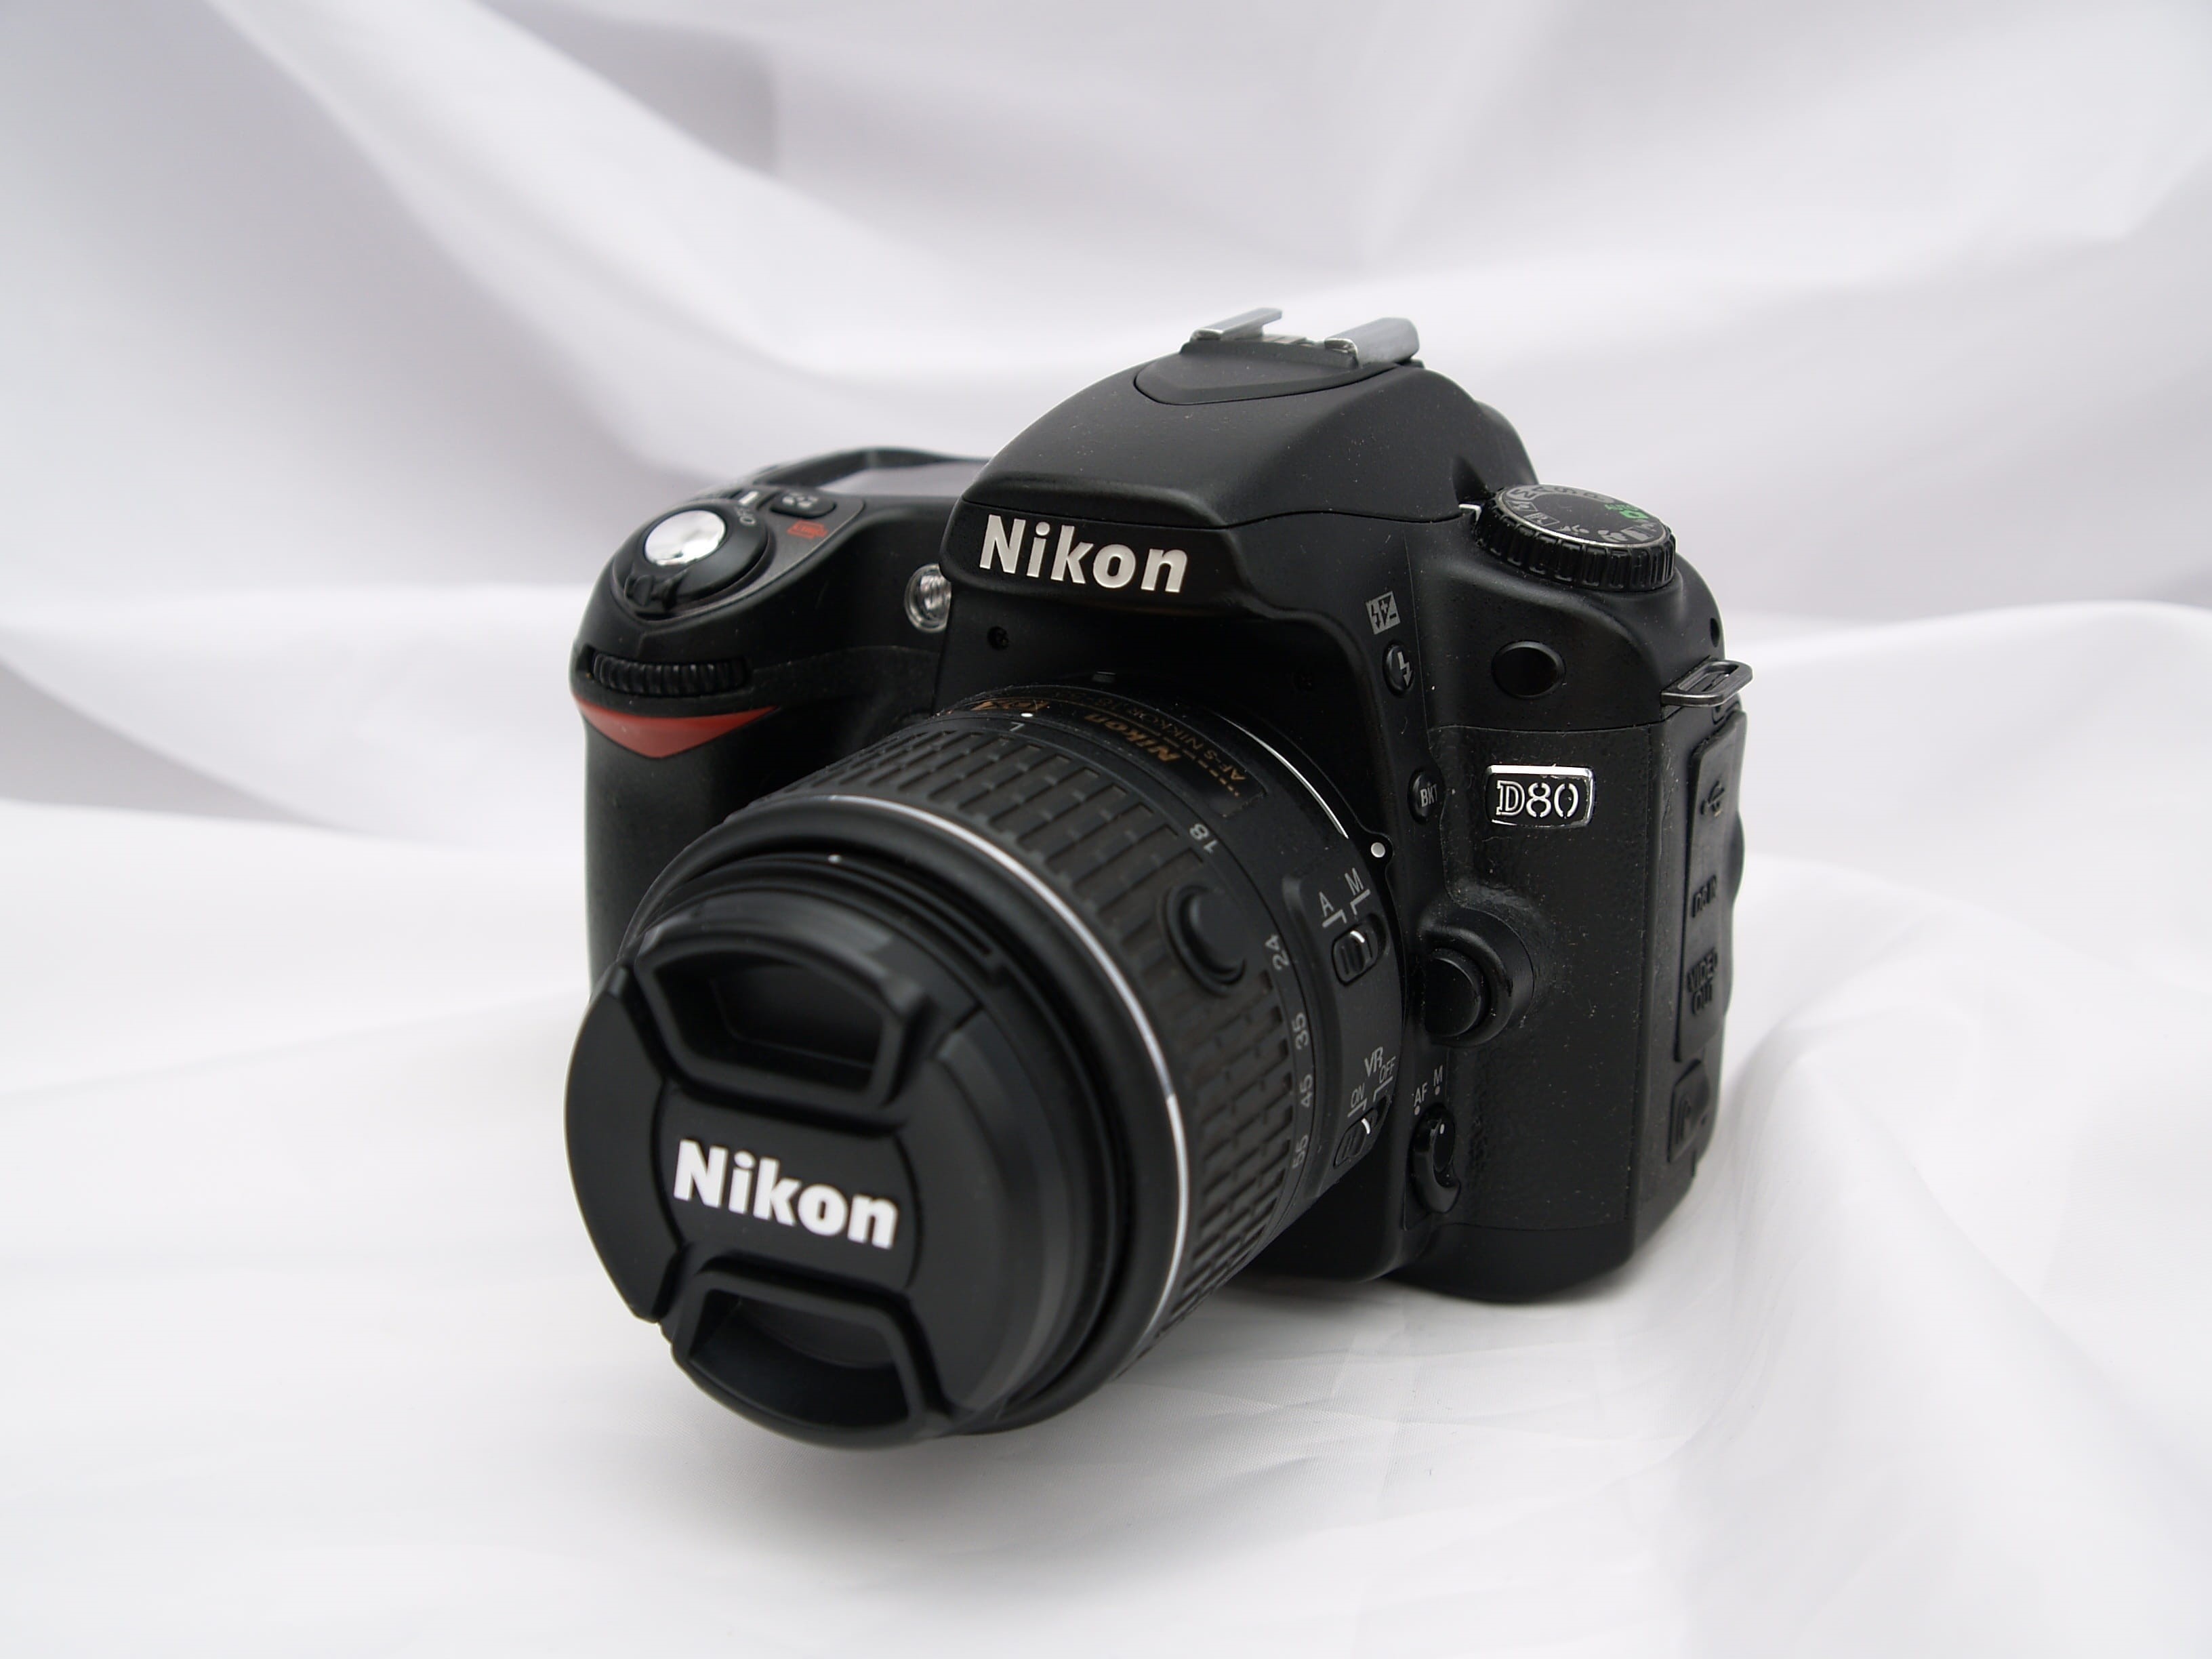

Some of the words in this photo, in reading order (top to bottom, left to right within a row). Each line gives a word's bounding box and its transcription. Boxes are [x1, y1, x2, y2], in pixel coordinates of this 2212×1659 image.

[980, 514, 1187, 593] Nikon
[1084, 714, 1181, 762] Nikon
[1204, 750, 1246, 780] AF-S
[1419, 783, 1437, 807] BKT
[1496, 779, 1578, 818] D80
[1189, 823, 1219, 855] 18
[1345, 867, 1364, 896] M
[1319, 890, 1334, 917] A
[1265, 935, 1289, 971] 24
[1292, 1012, 1309, 1050] 35
[1364, 1046, 1383, 1078] VR
[1379, 1056, 1396, 1084] OFF
[1433, 1065, 1443, 1086] M
[1300, 1073, 1313, 1109] 45
[1351, 1082, 1365, 1109] ON
[1414, 1082, 1427, 1107] AF
[1292, 1134, 1309, 1169] 55
[674, 1139, 898, 1250] Nikon
